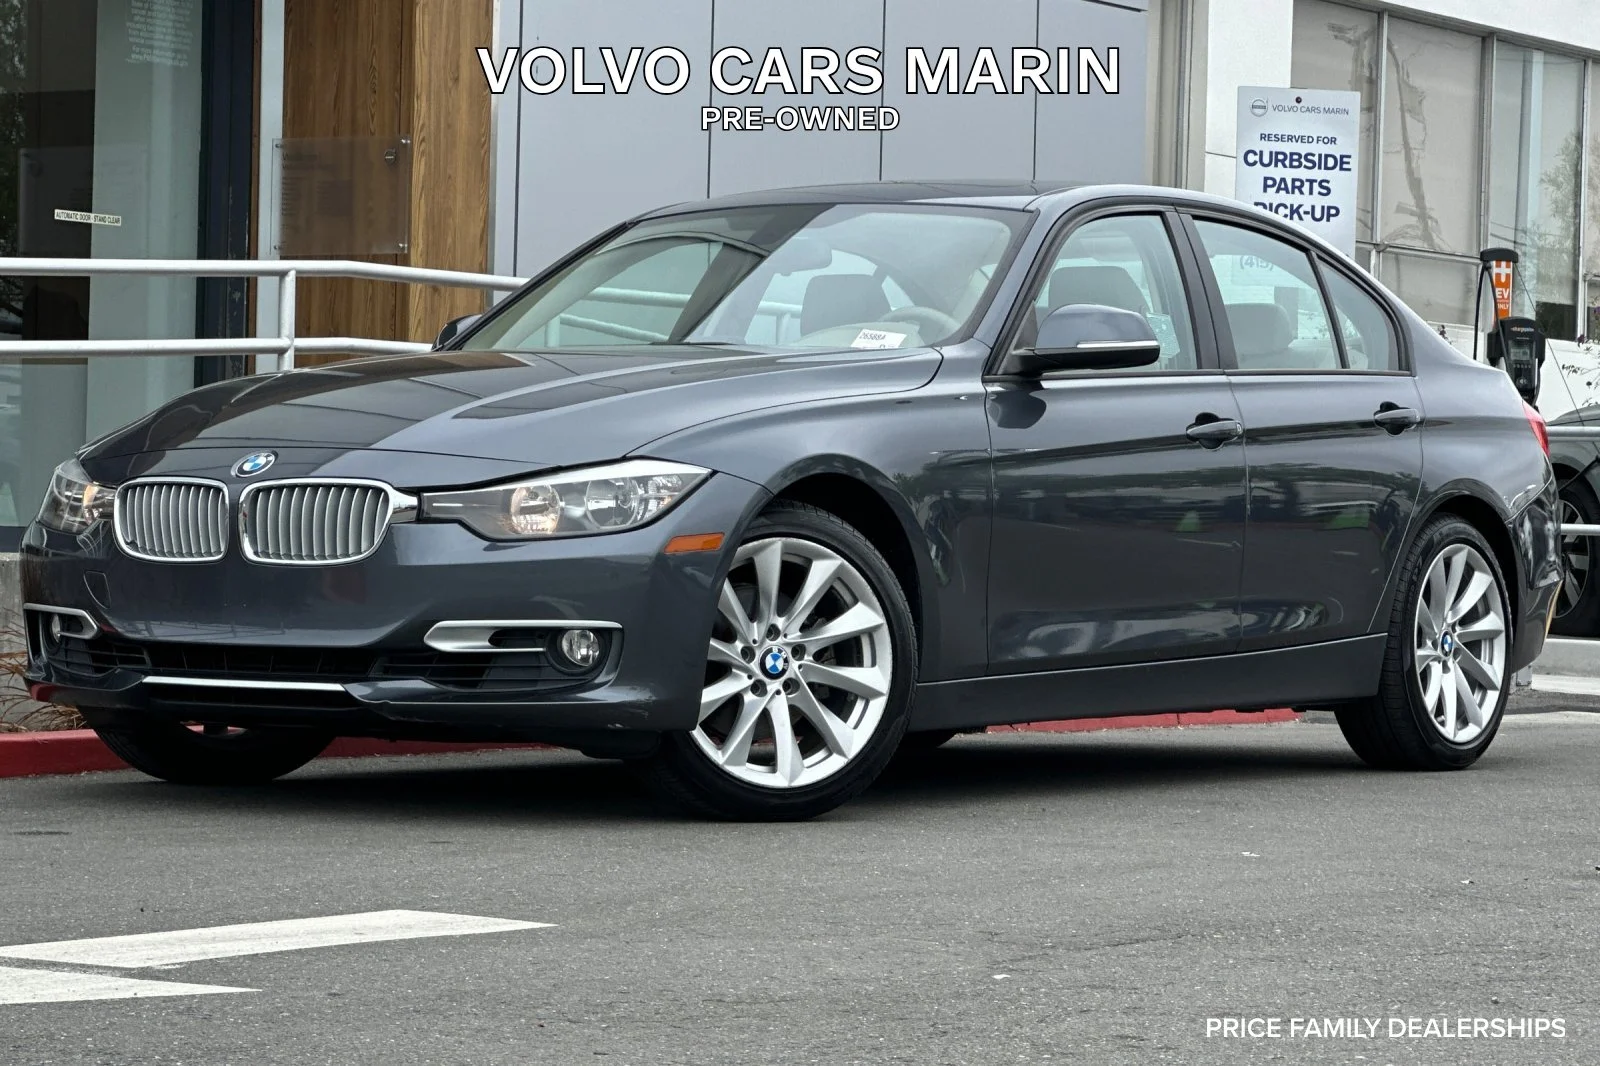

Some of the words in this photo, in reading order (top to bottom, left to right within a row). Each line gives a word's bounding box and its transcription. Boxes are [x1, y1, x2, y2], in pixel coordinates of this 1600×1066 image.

[1272, 104, 1298, 113] VOLVO
[1300, 105, 1321, 114] CARS
[1323, 106, 1349, 115] MARIN
[1259, 133, 1314, 144] RESERVED
[1316, 135, 1337, 145] FOR
[1243, 149, 1352, 172] CURBSIDE
[1262, 176, 1332, 197] PARTS
[56, 211, 78, 220] AUTOMATIC
[1497, 287, 1509, 299] EV
